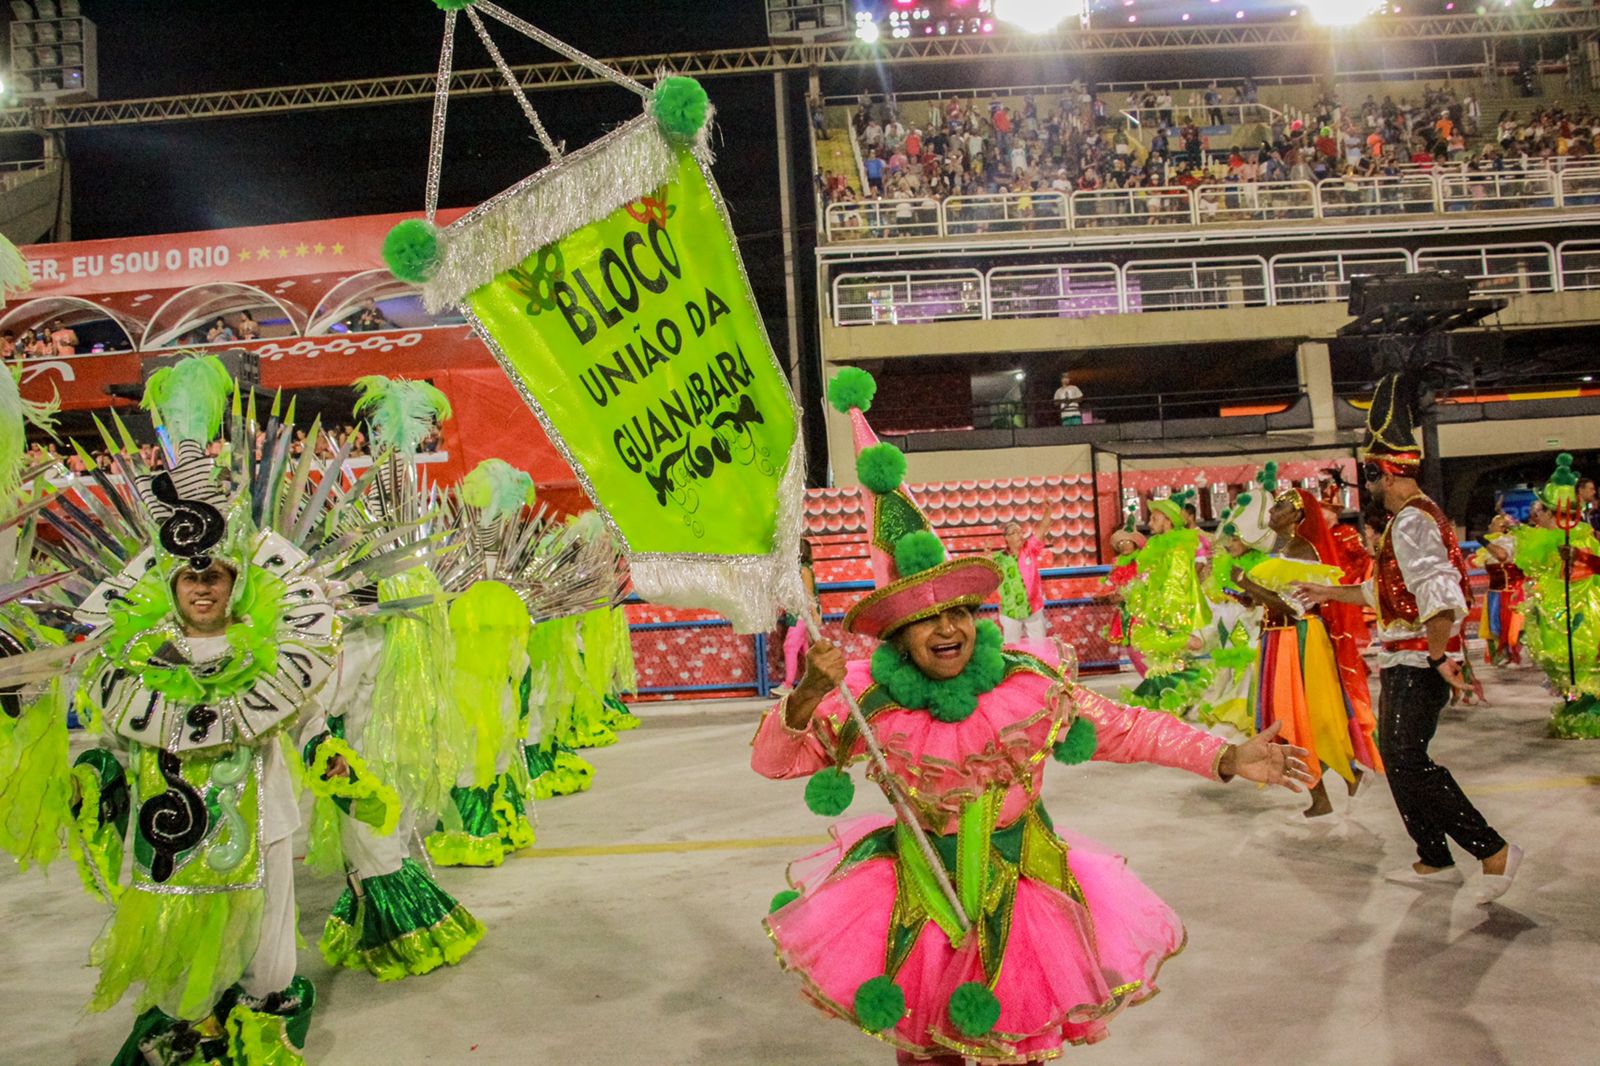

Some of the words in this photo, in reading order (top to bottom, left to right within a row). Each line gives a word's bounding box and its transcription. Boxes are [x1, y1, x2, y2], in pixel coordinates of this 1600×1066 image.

[27, 258, 66, 283] ER,
[73, 255, 104, 278] EU
[110, 251, 159, 275] SOU
[166, 249, 181, 271] O
[188, 245, 229, 269] RIO
[555, 219, 681, 346] BLOCO
[579, 318, 682, 408] UNIÃO
[684, 287, 731, 338] DA
[613, 343, 755, 474] GUANABARA
